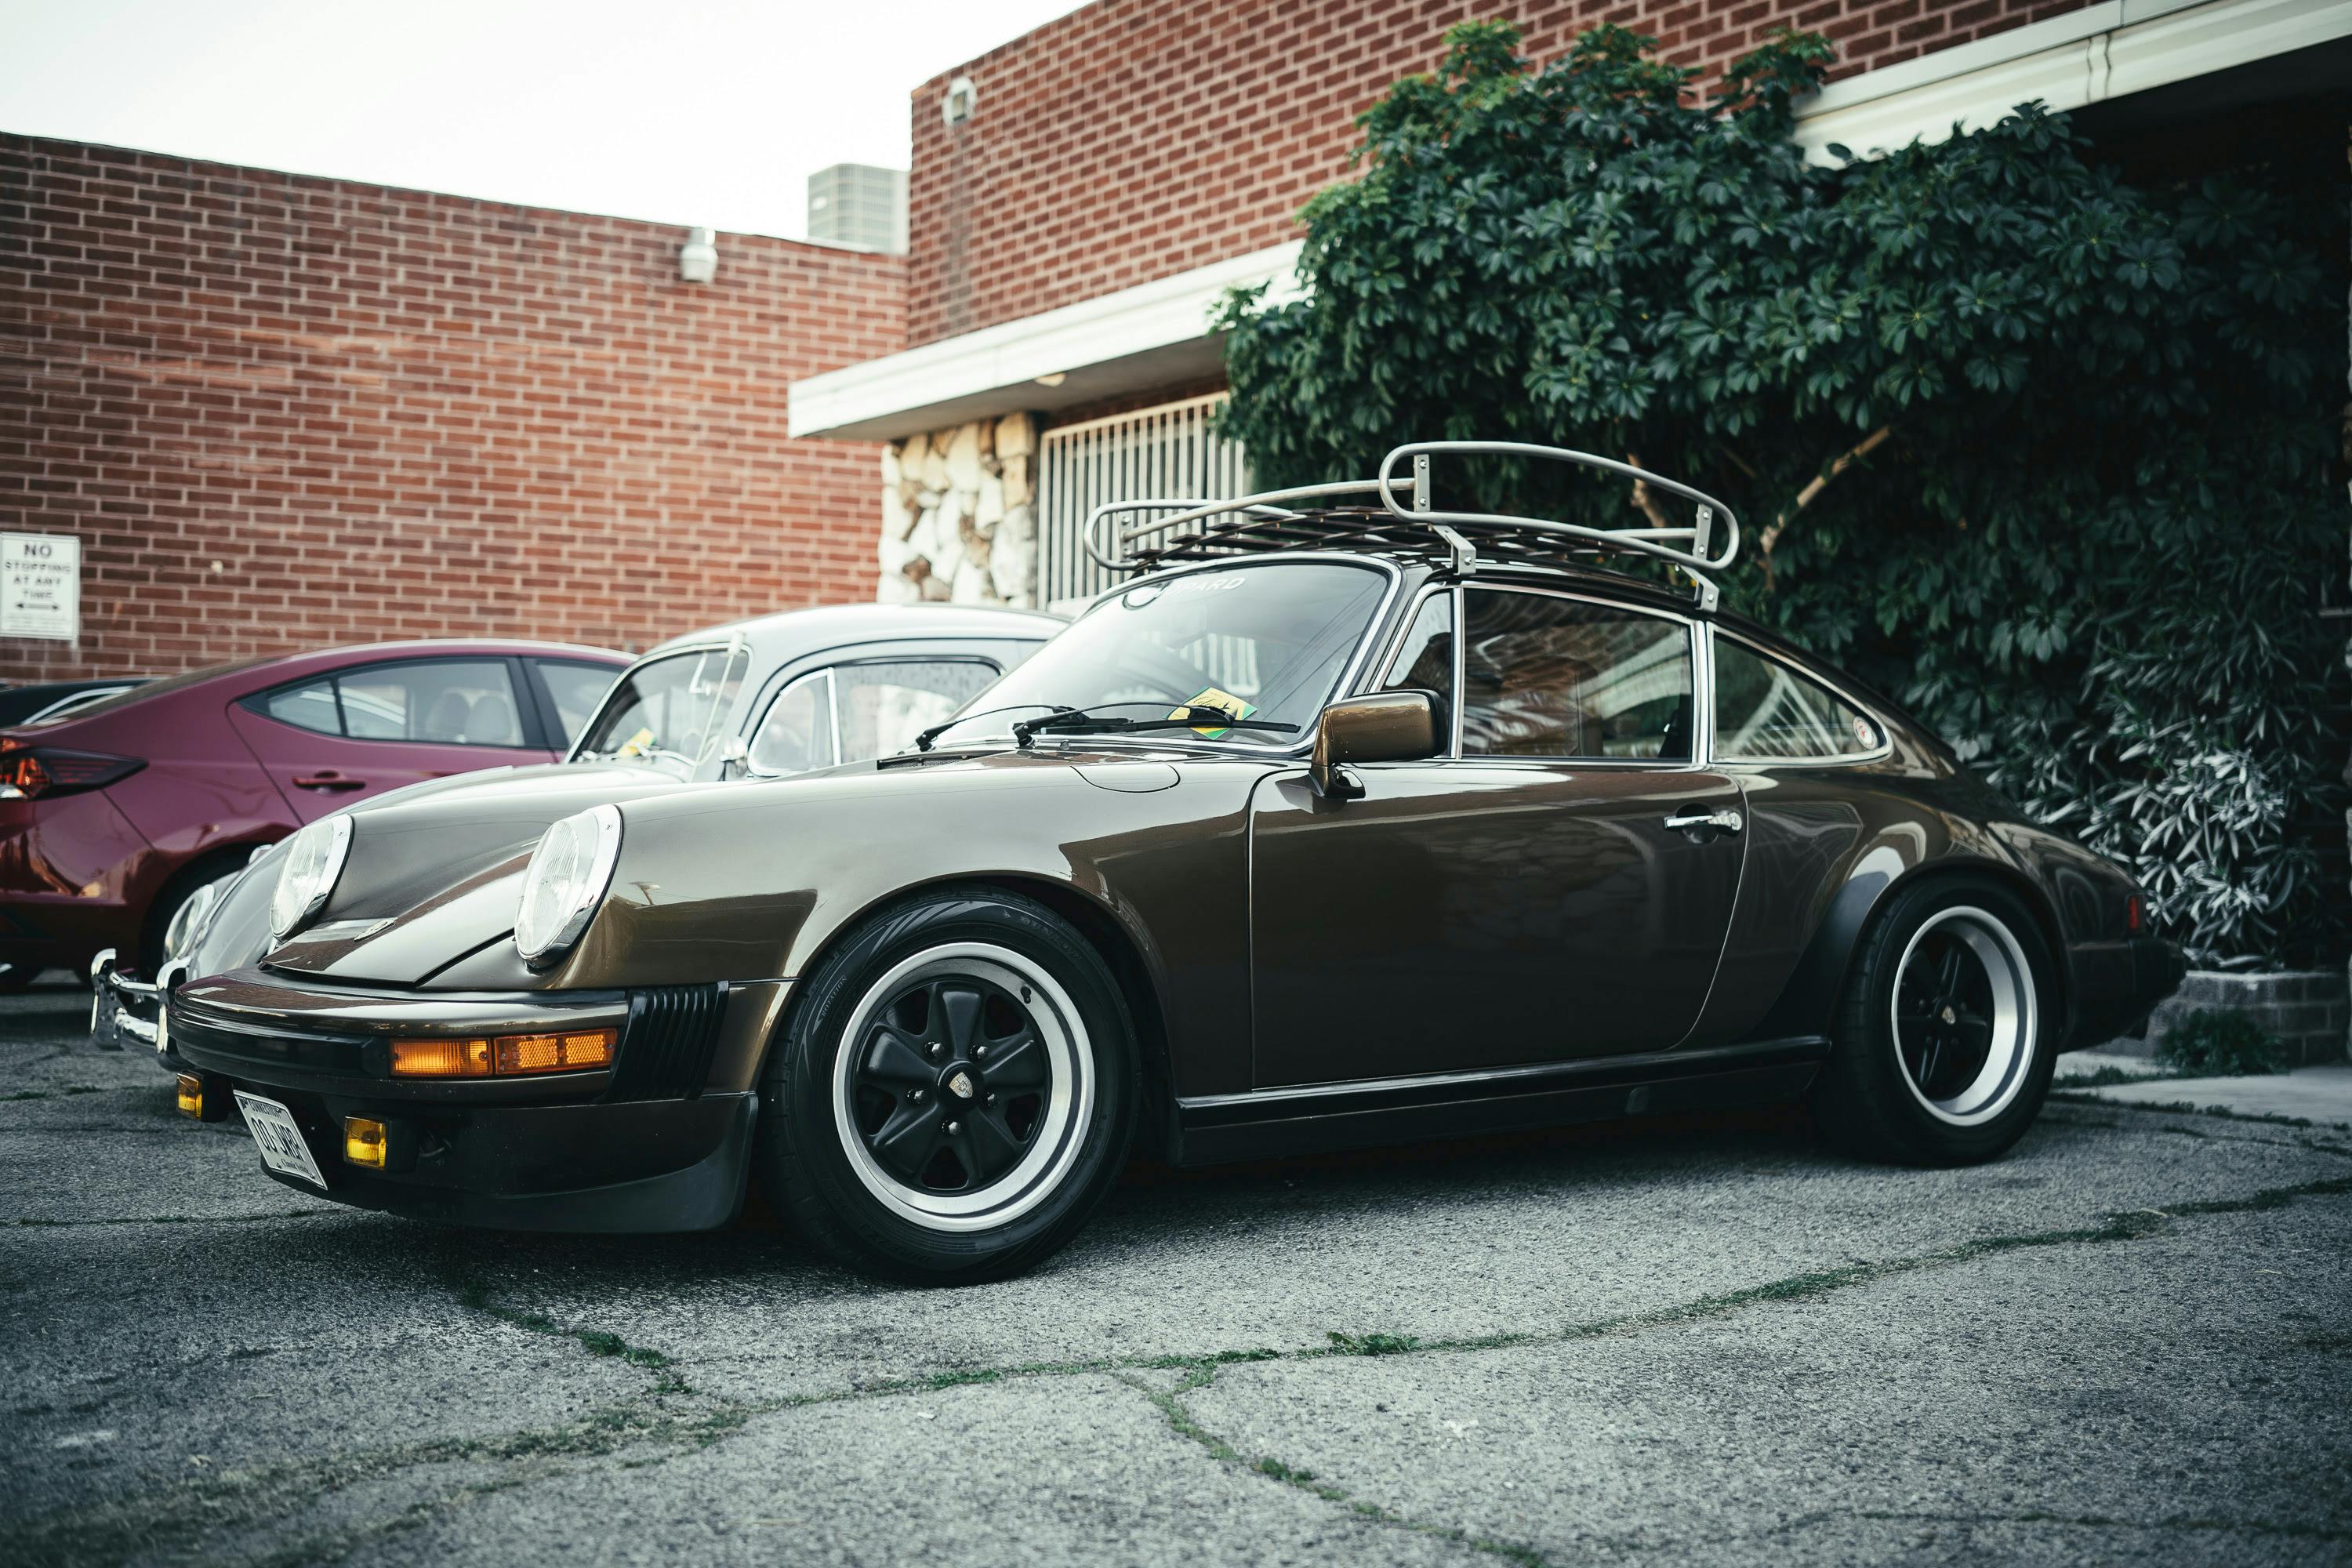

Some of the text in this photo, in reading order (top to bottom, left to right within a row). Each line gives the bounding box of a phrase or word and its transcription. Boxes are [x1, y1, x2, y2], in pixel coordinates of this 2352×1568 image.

[24, 543, 53, 558] NO
[13, 575, 61, 586] AT ANY
[248, 1099, 281, 1118] CONNECTICUT
